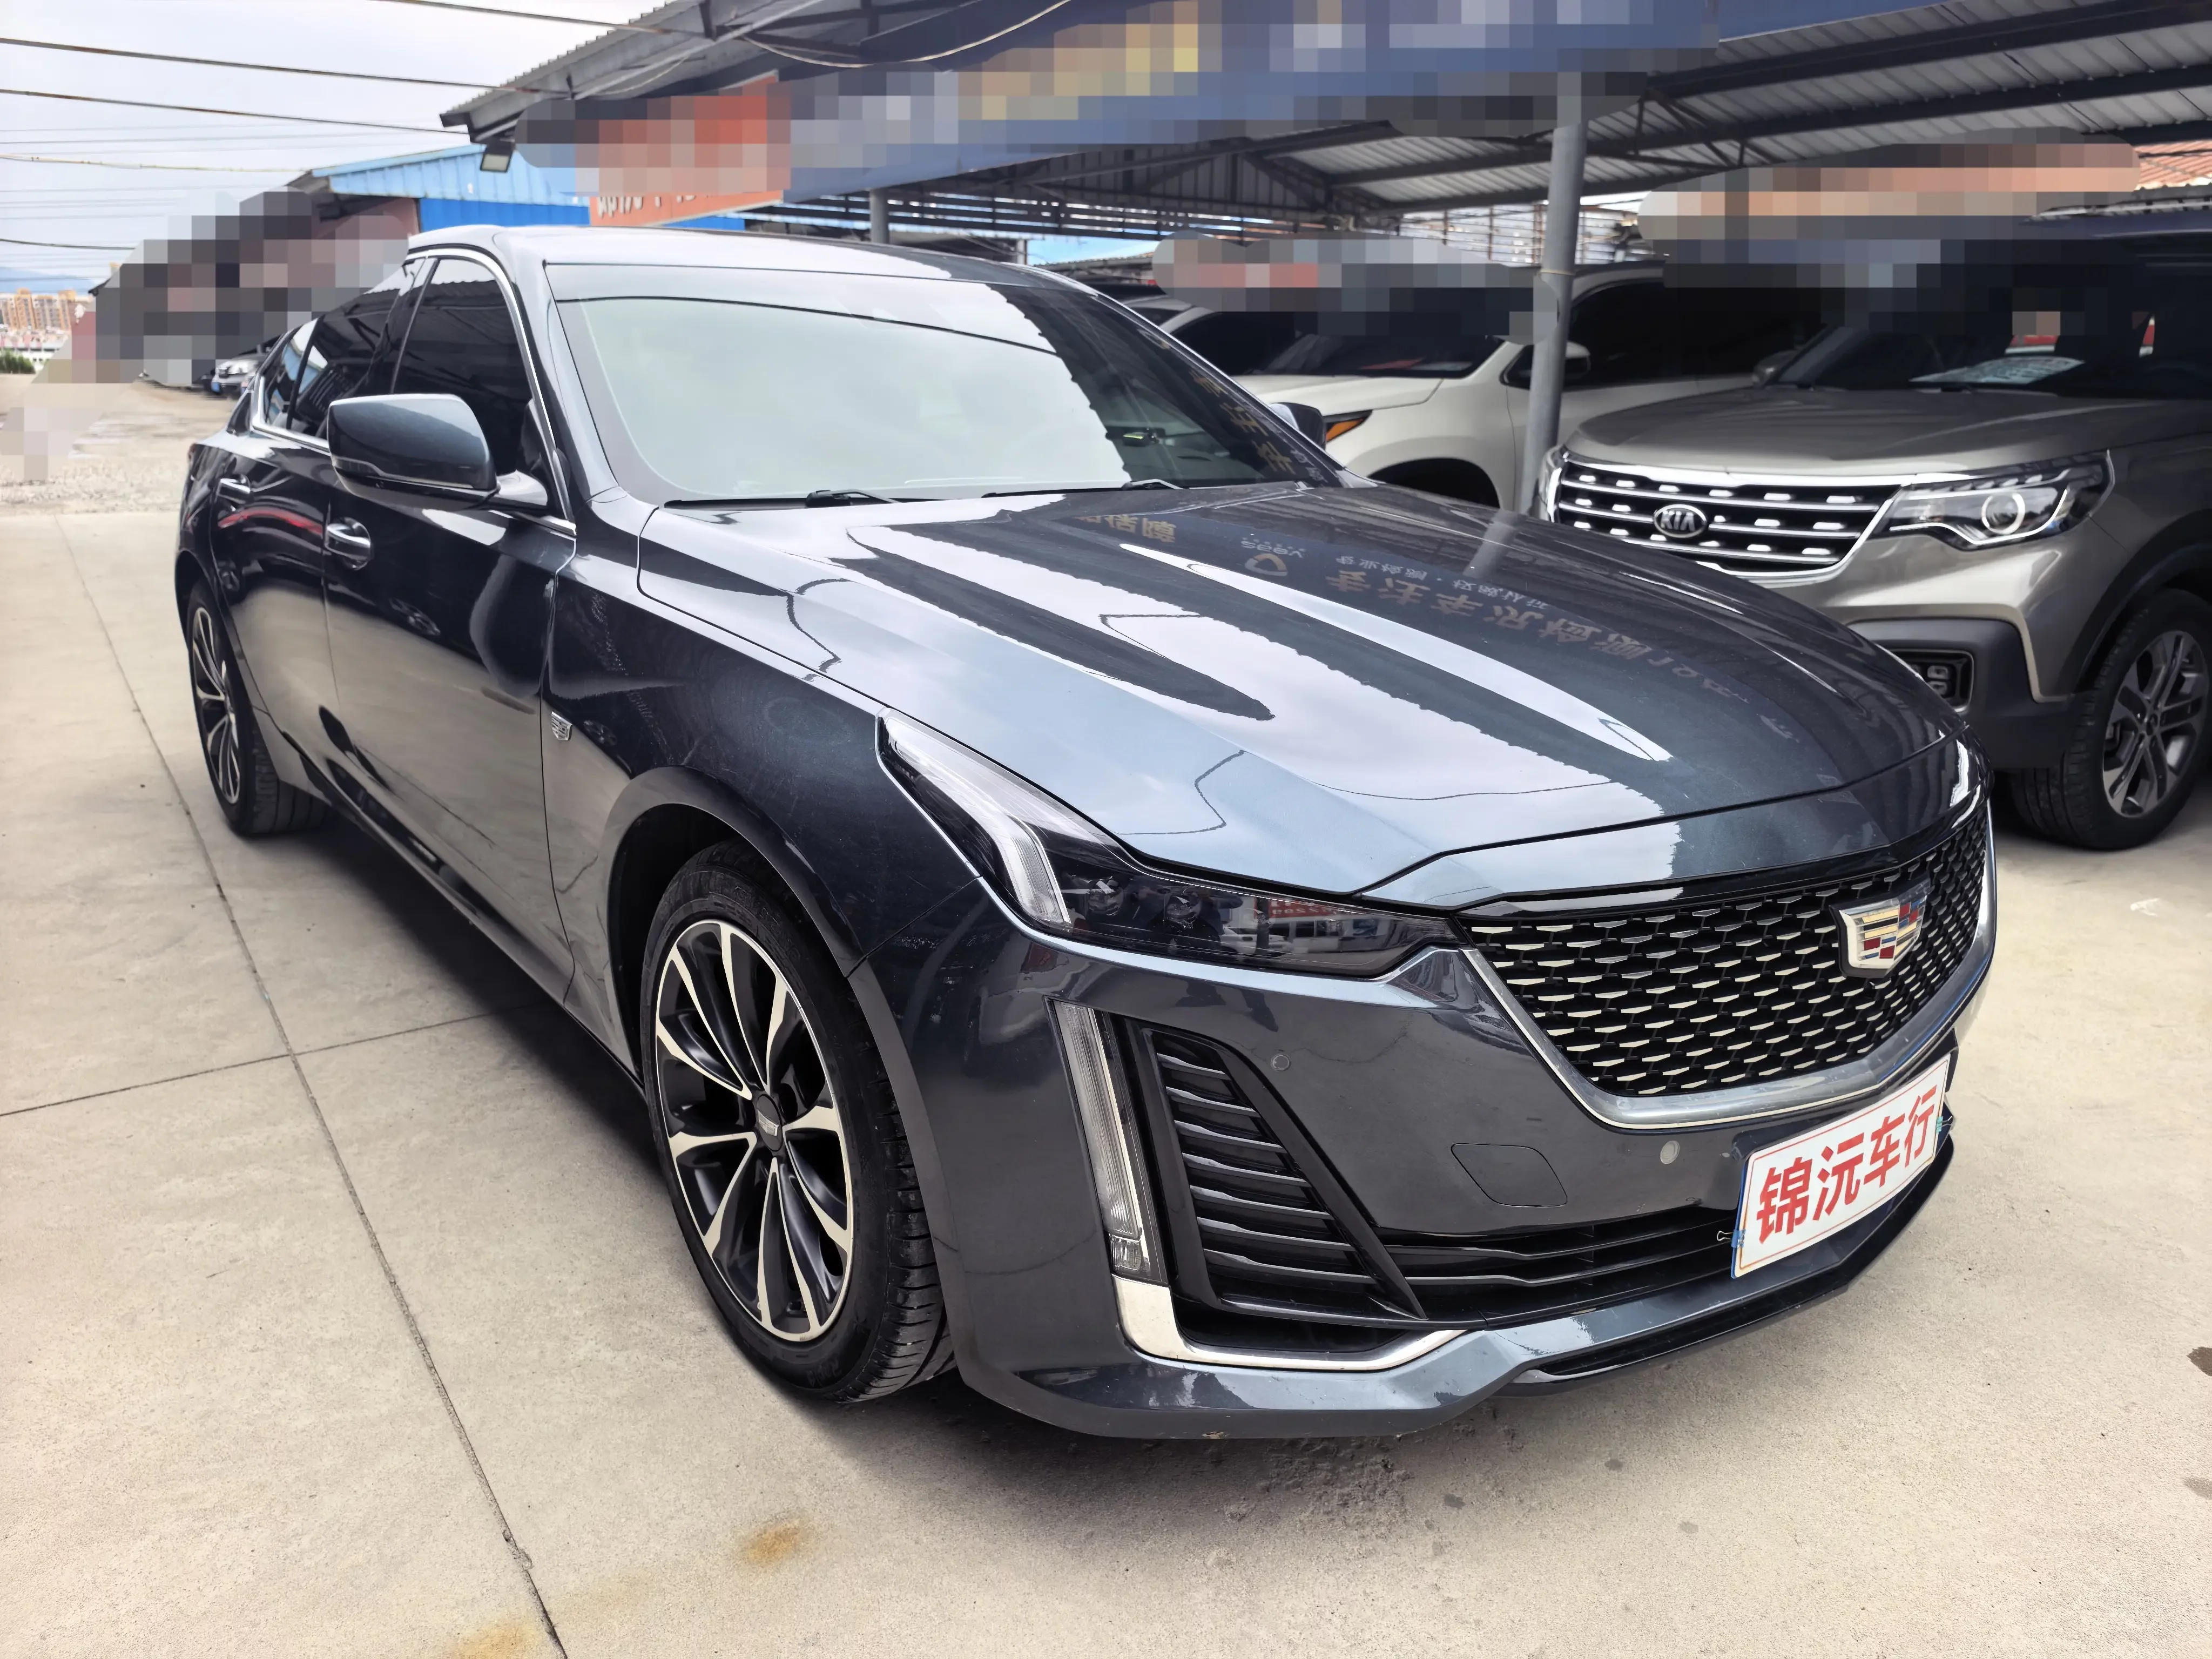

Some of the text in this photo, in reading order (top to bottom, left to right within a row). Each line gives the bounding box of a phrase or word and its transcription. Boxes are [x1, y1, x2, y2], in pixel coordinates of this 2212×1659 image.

[1661, 510, 1696, 531] KIA
[1757, 1084, 1938, 1244] 锦沅车行
